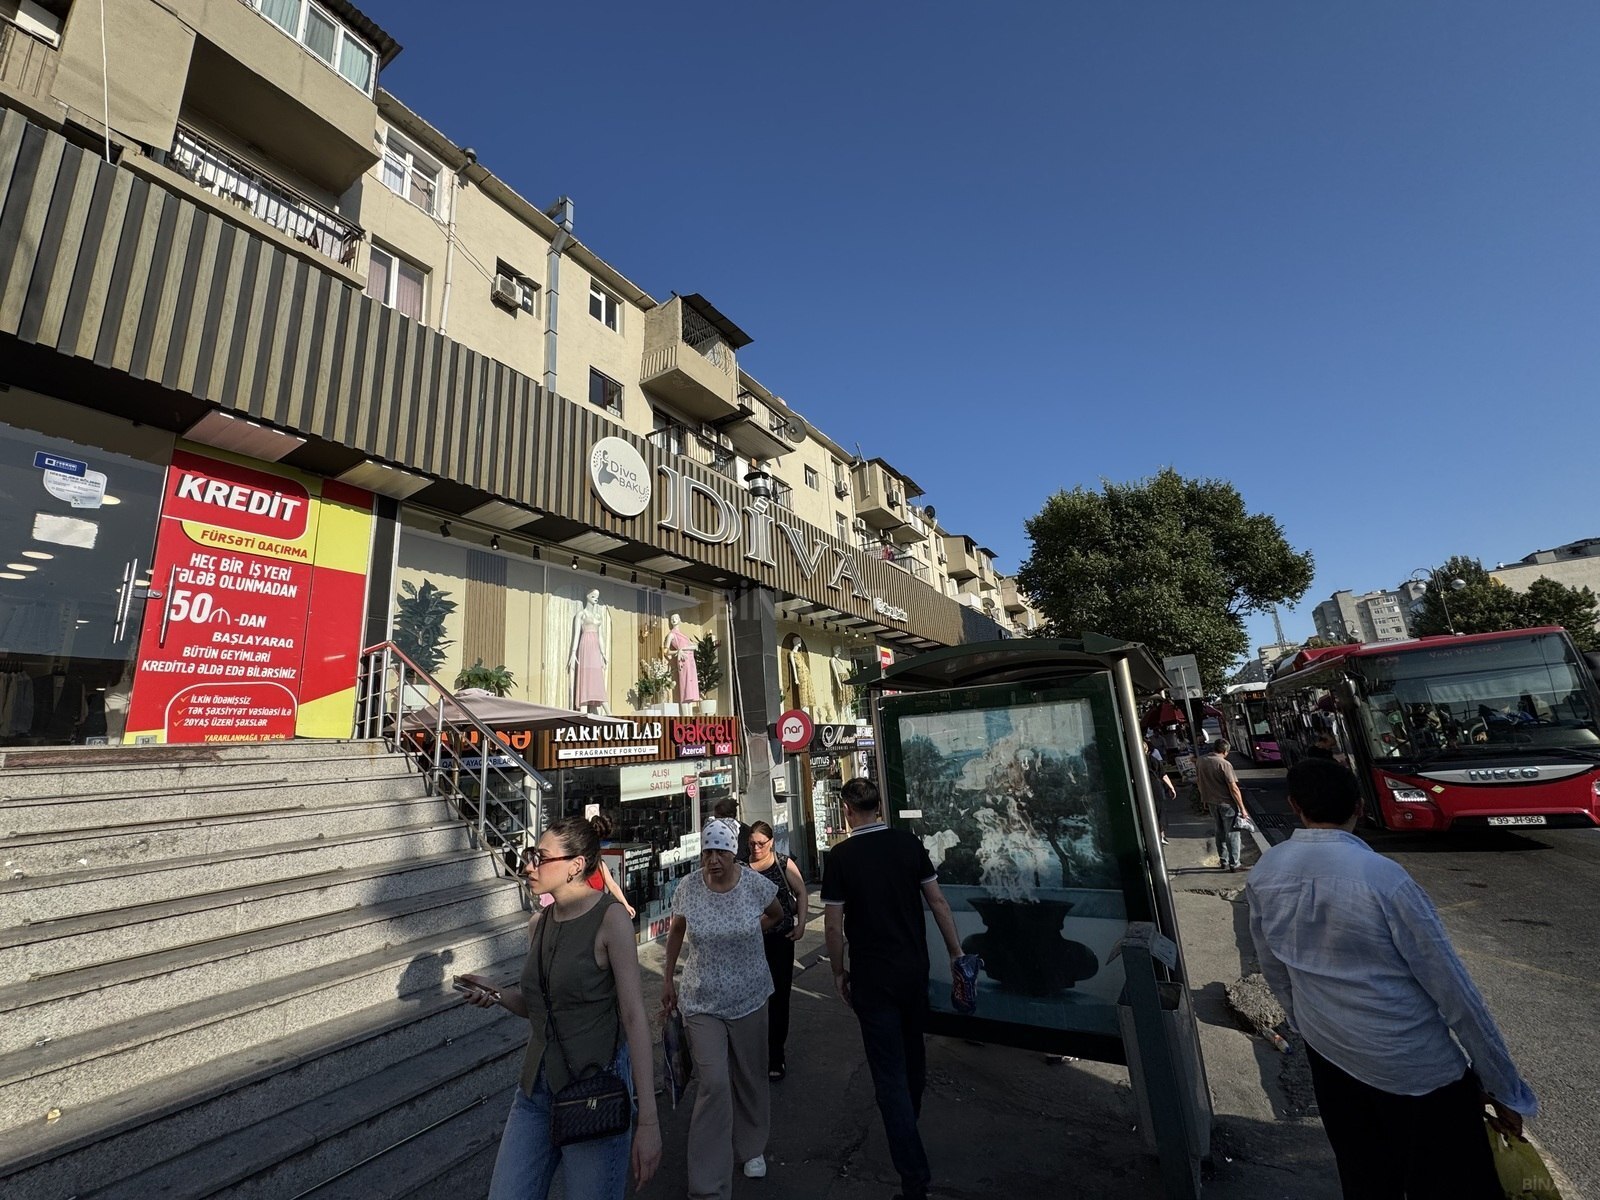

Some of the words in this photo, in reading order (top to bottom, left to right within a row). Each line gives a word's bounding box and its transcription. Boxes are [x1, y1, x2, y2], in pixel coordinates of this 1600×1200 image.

[611, 461, 637, 481] Diva
[620, 478, 646, 495] BAKU
[177, 474, 302, 522] KREDİT
[258, 541, 308, 558] QAÇIRMA
[189, 553, 217, 572] HEÇ
[219, 556, 244, 574] BİR
[249, 560, 262, 578] İŞ
[264, 564, 292, 581] YERİ
[175, 567, 216, 586] ƏLƏB
[219, 575, 297, 598] OLUNMADAN
[212, 631, 294, 648] BAŞLAYARAQ
[182, 645, 218, 659] BÜTÜN
[141, 660, 194, 673] KREDİTLƏ
[190, 694, 211, 703] İLKİN
[632, 721, 663, 740] LAB
[673, 719, 737, 743] bakcell
[784, 725, 803, 735] nar
[574, 748, 617, 757] FRAGRANCE
[682, 746, 706, 755] Azercell
[651, 769, 670, 778] ALIŞI
[1468, 767, 1540, 781] IVECO
[649, 782, 672, 791] SATIŞI
